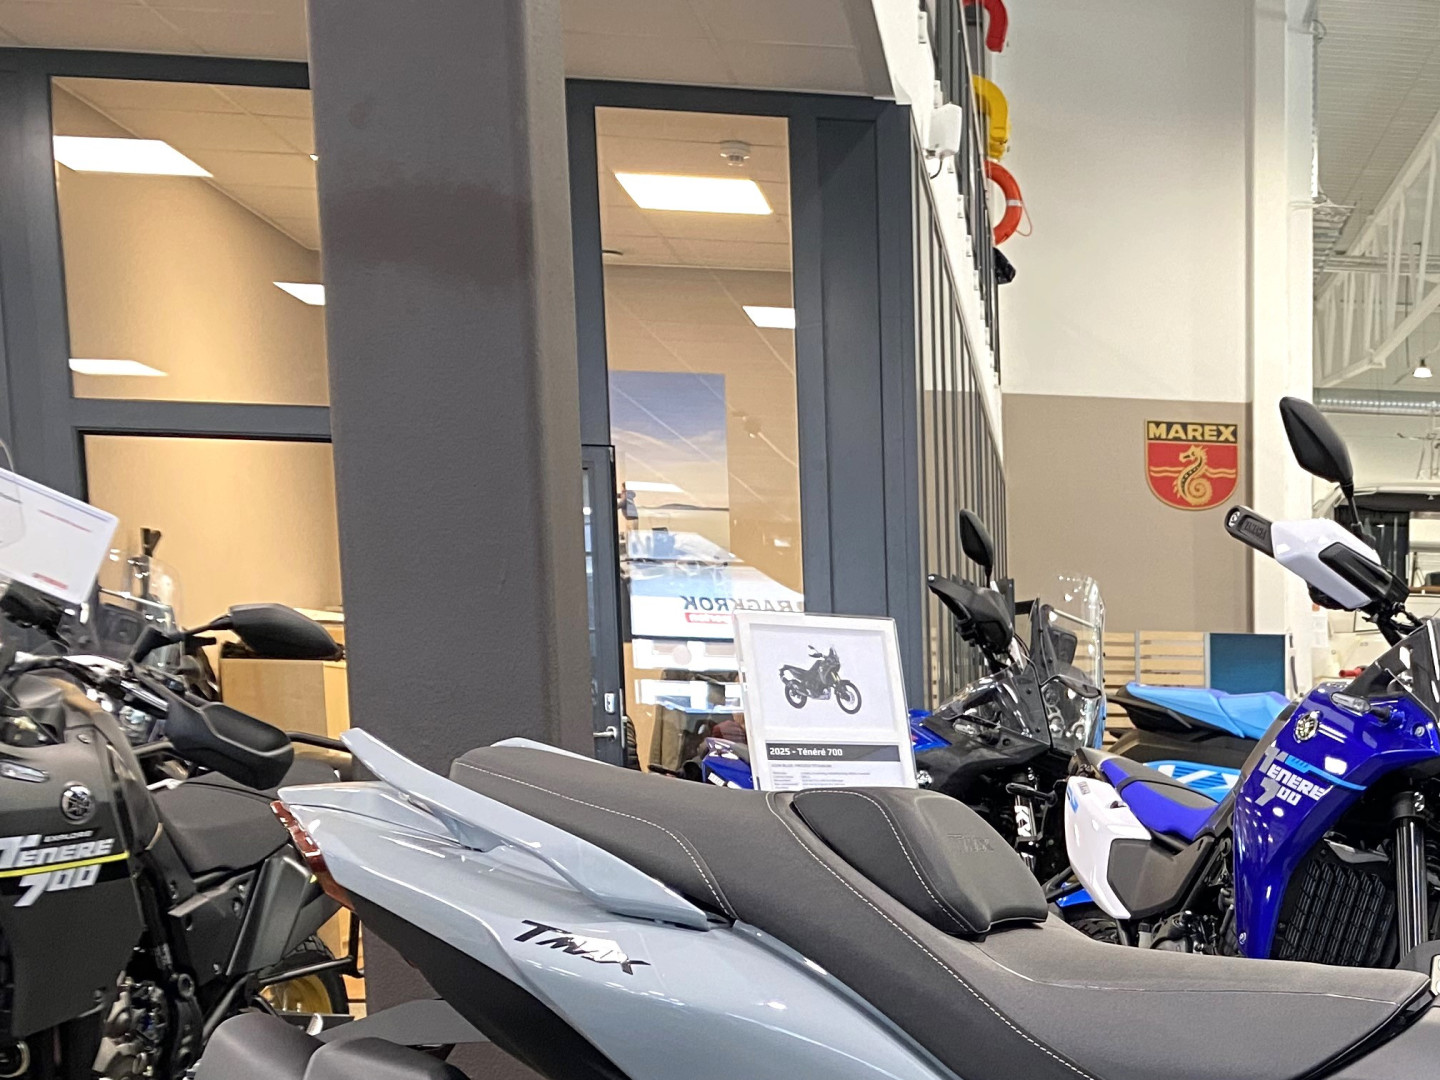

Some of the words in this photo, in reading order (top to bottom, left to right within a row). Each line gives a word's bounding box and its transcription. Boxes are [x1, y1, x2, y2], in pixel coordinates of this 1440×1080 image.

[1148, 422, 1236, 442] MAREX
[769, 747, 791, 756] 2025
[798, 747, 826, 757] Ténéré
[828, 748, 843, 757] 700
[1254, 777, 1302, 807] 700
[13, 863, 102, 908] 700
